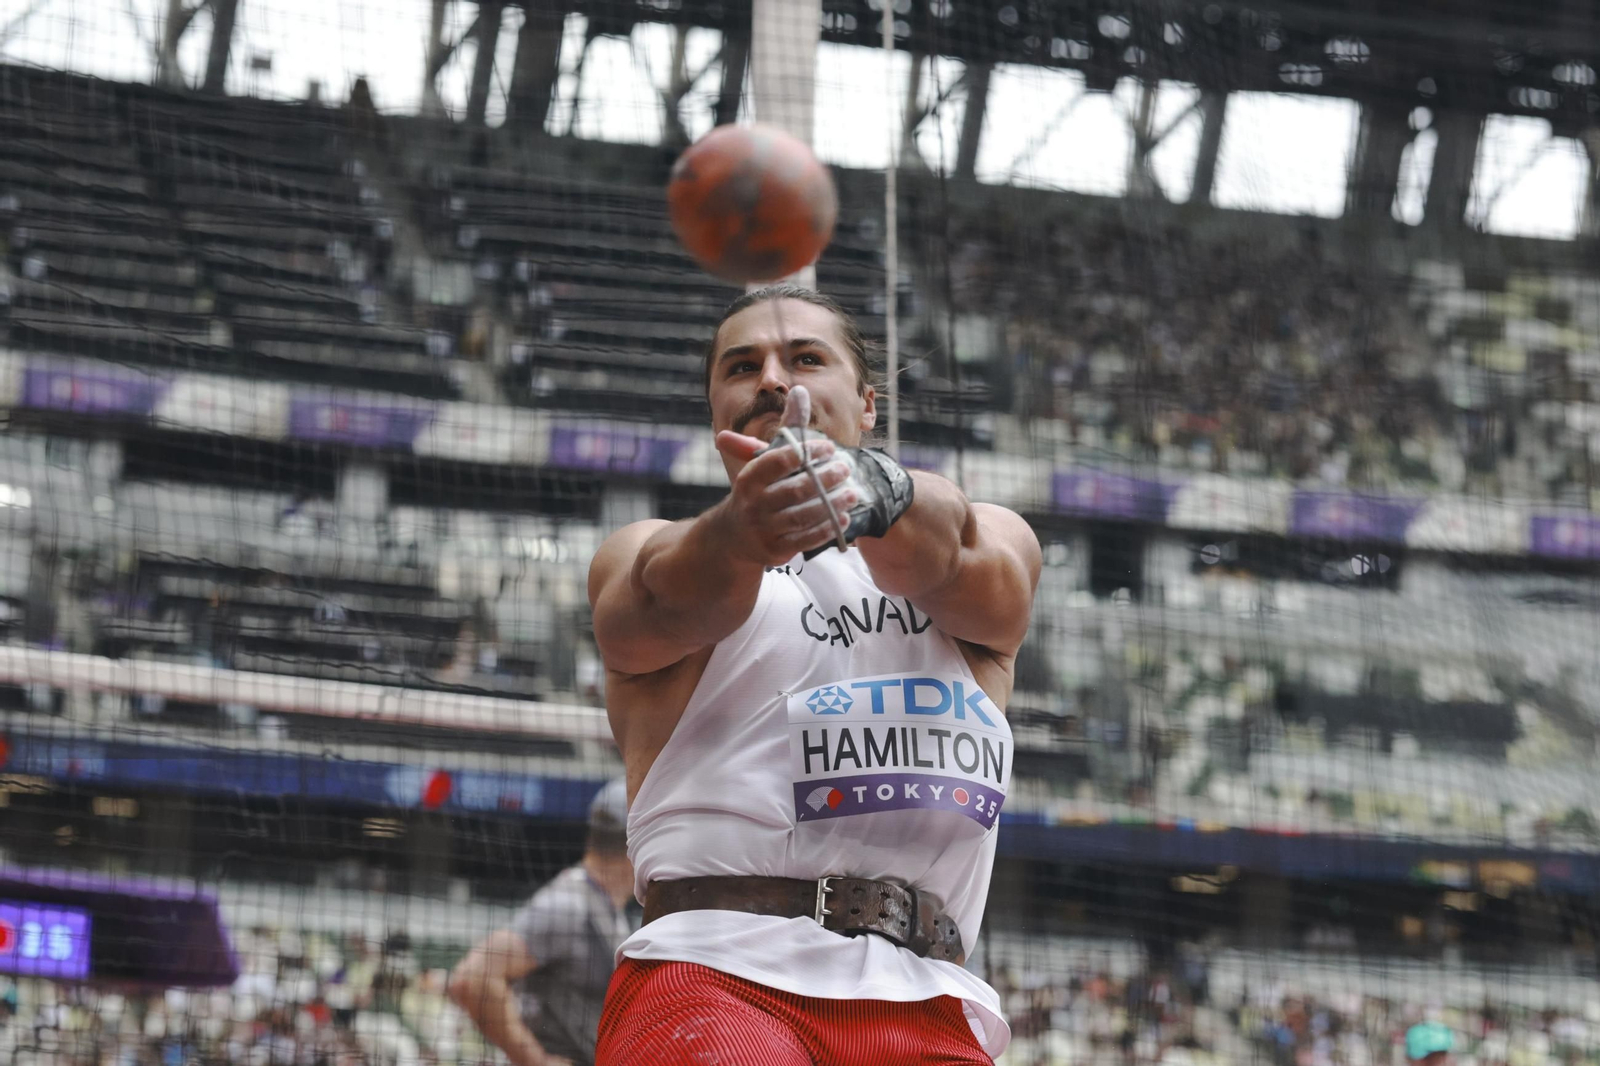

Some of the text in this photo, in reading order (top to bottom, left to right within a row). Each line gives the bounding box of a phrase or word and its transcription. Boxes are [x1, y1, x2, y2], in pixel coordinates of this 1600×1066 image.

[801, 596, 933, 648] CANAD
[851, 677, 998, 728] TDK
[802, 726, 1004, 784] HAMILTON
[975, 794, 998, 819] 25
